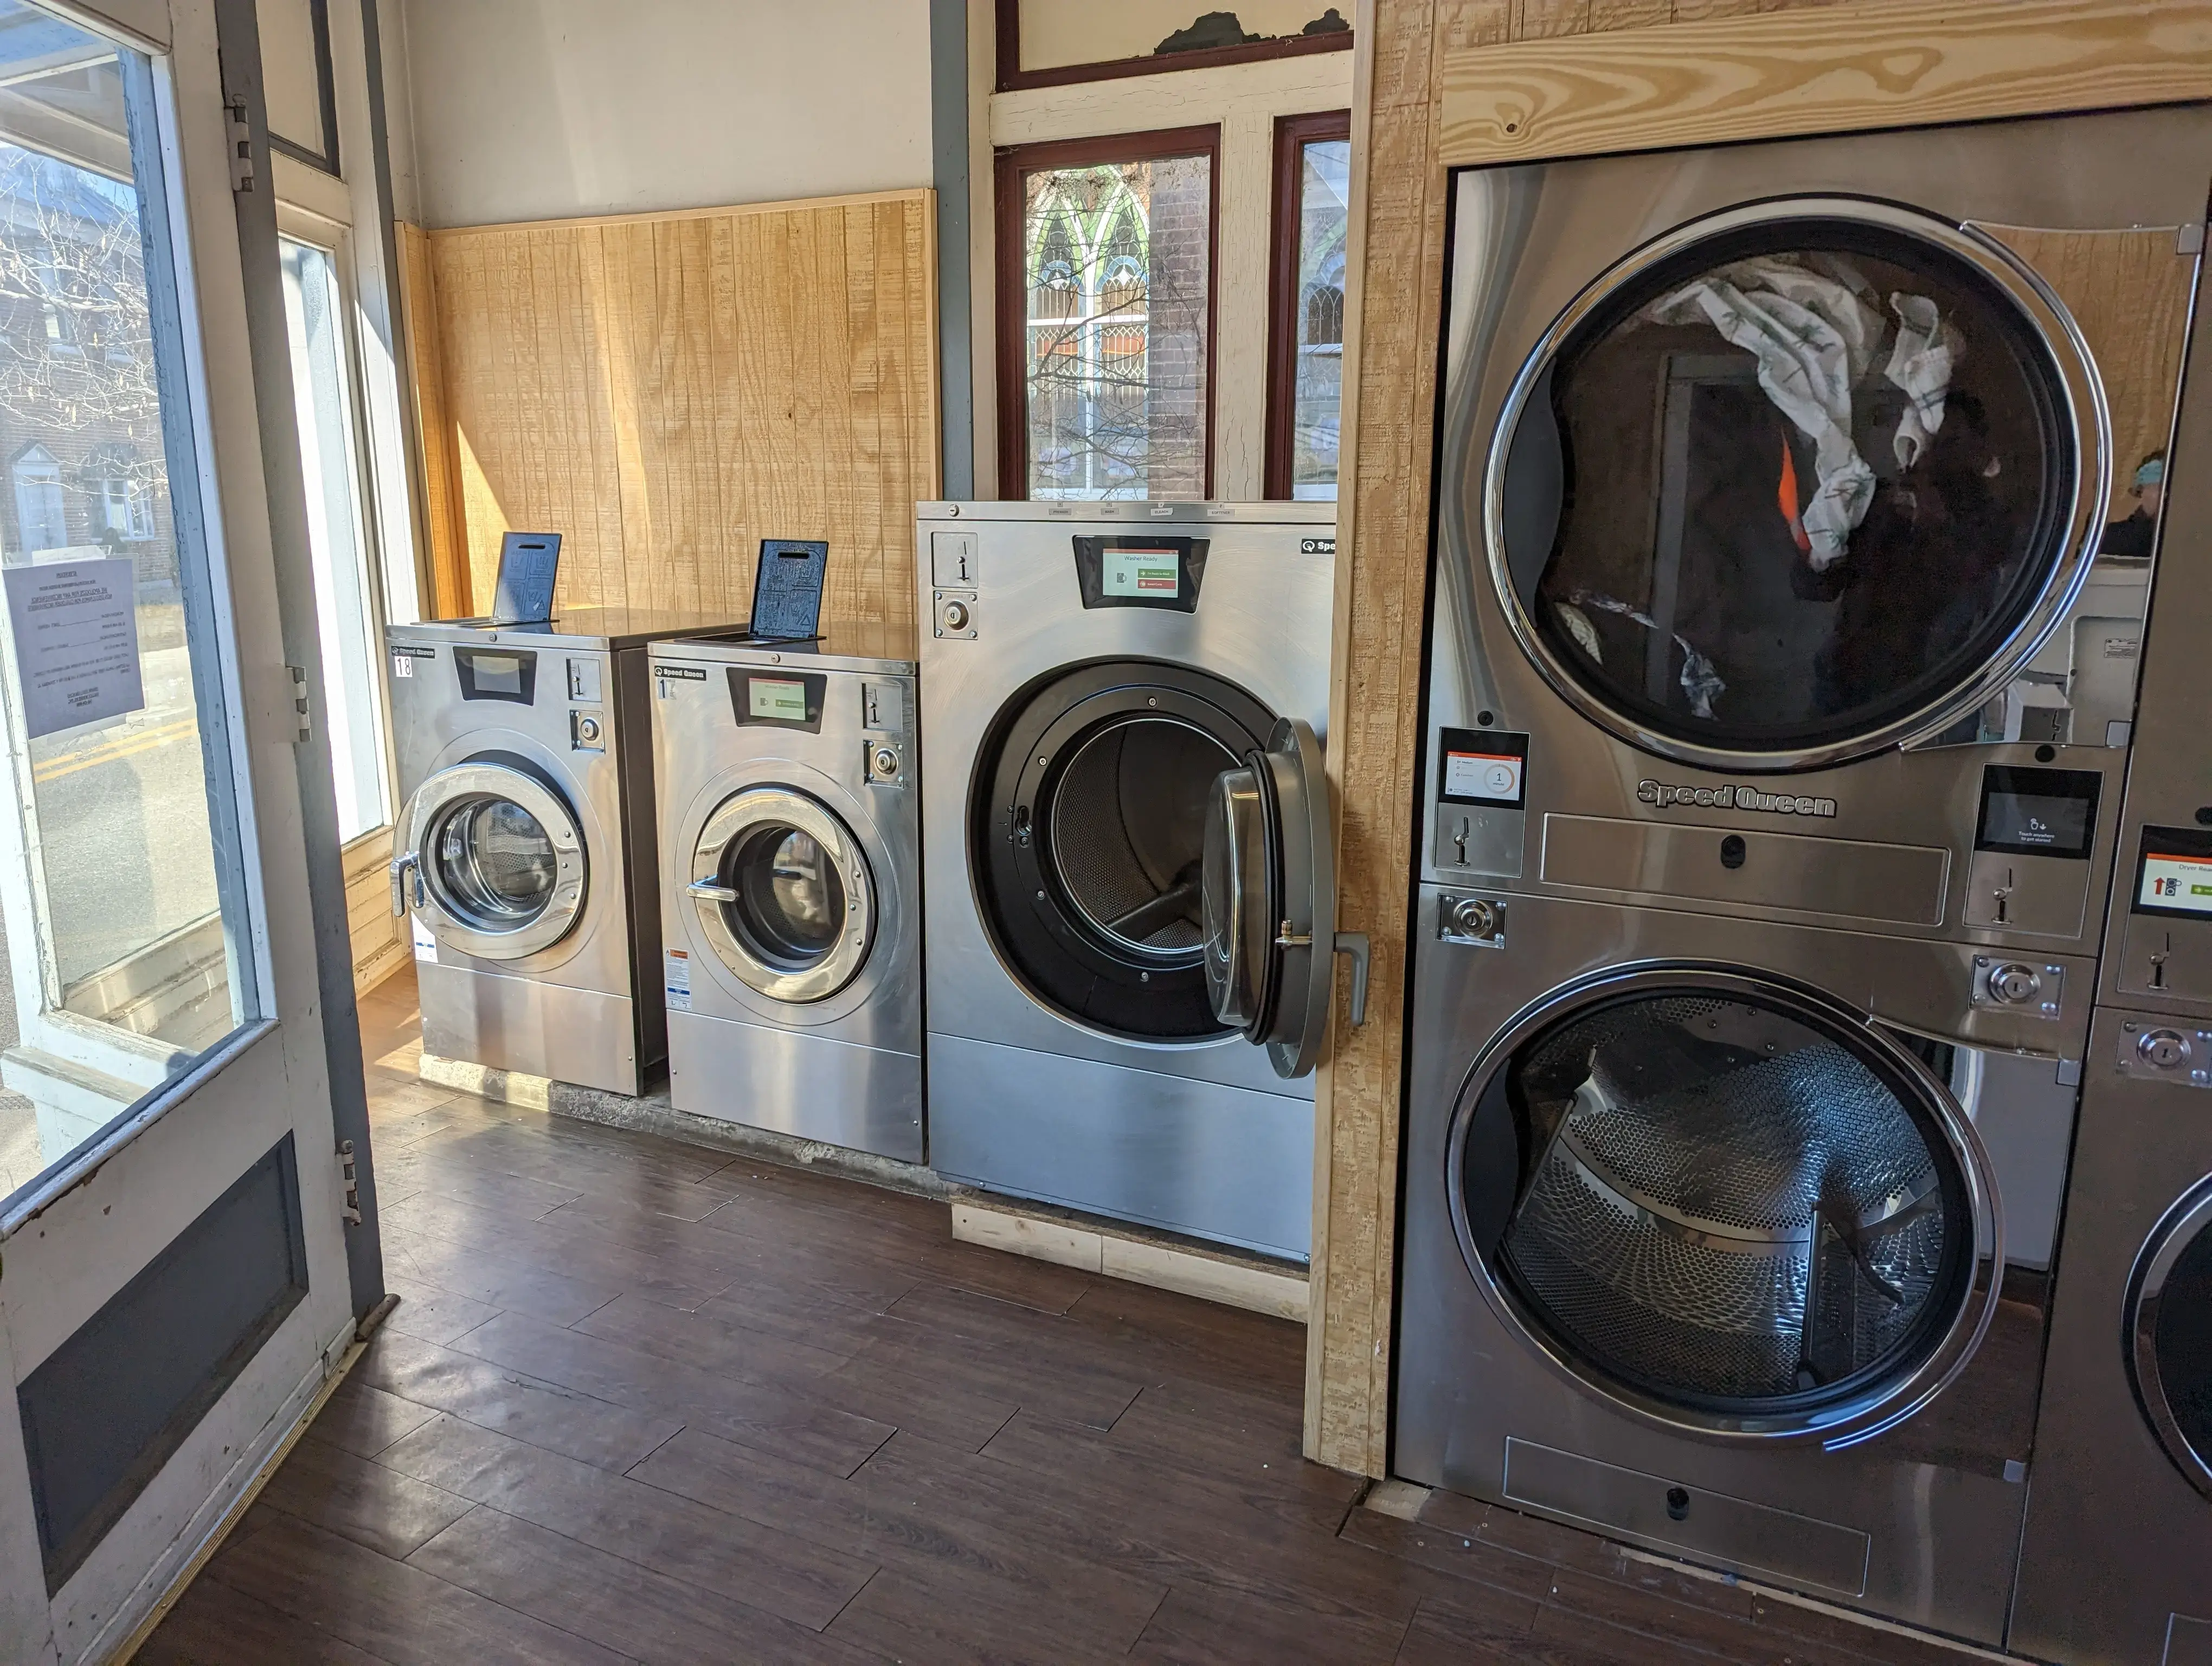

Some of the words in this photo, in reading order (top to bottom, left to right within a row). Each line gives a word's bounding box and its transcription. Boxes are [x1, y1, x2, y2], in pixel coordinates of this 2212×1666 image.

[397, 658, 411, 675] 18
[663, 668, 683, 676] Speed
[684, 670, 704, 678] Queen
[1496, 773, 1502, 781] 1
[1638, 779, 1735, 808] Speed
[1735, 785, 1836, 817] Queen
